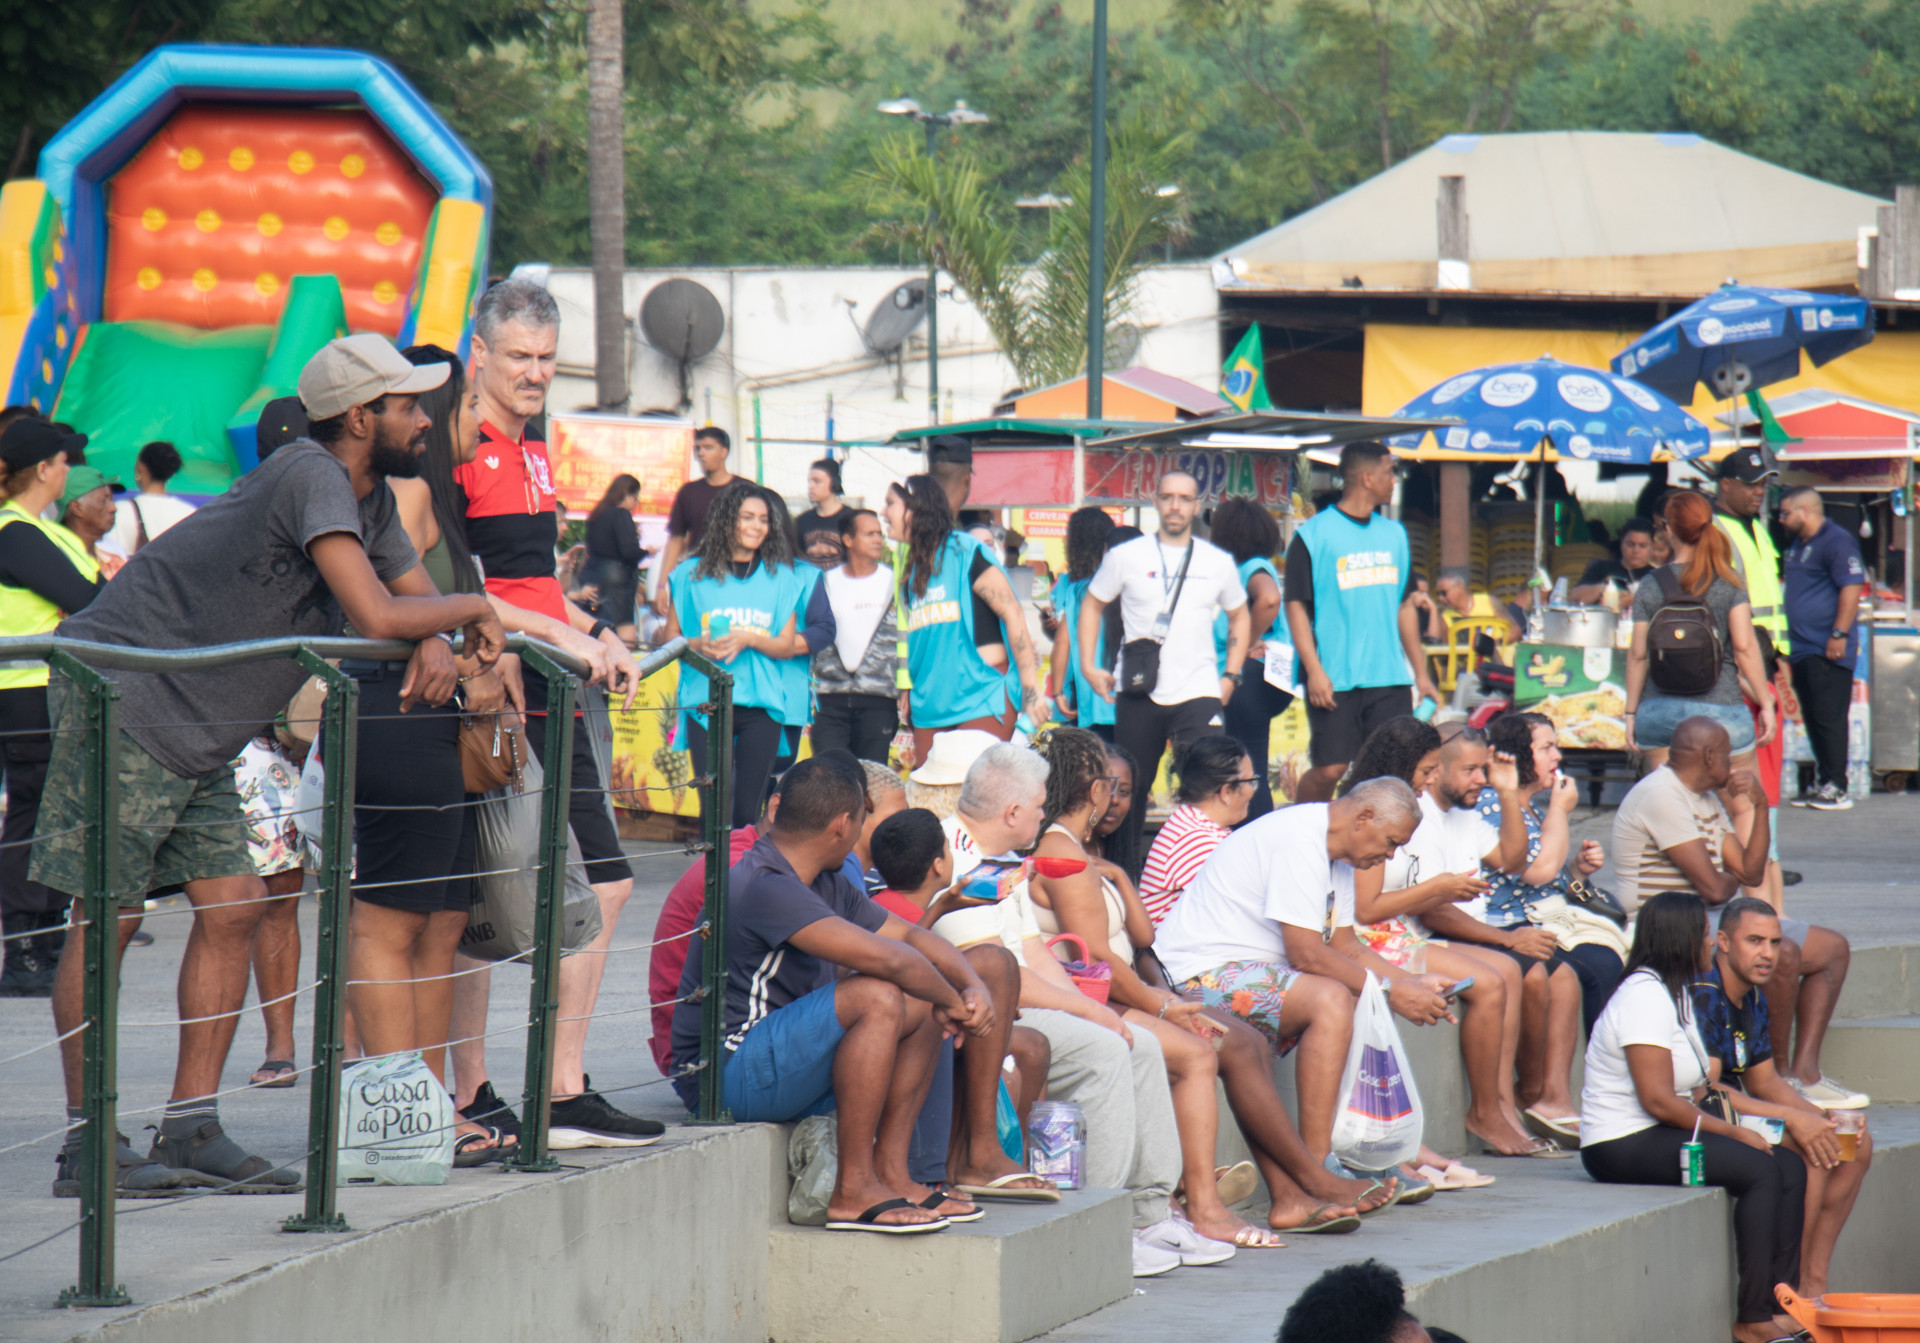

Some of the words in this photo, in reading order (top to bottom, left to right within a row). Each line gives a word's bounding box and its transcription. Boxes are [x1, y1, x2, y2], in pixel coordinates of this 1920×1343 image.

[1491, 379, 1529, 394] bet
[1563, 380, 1604, 399] bet
[554, 462, 571, 486] 4
[1028, 510, 1068, 521] CERVEJA
[360, 1080, 430, 1107] Casa
[357, 1111, 380, 1134] do
[375, 1105, 432, 1139] Pão
